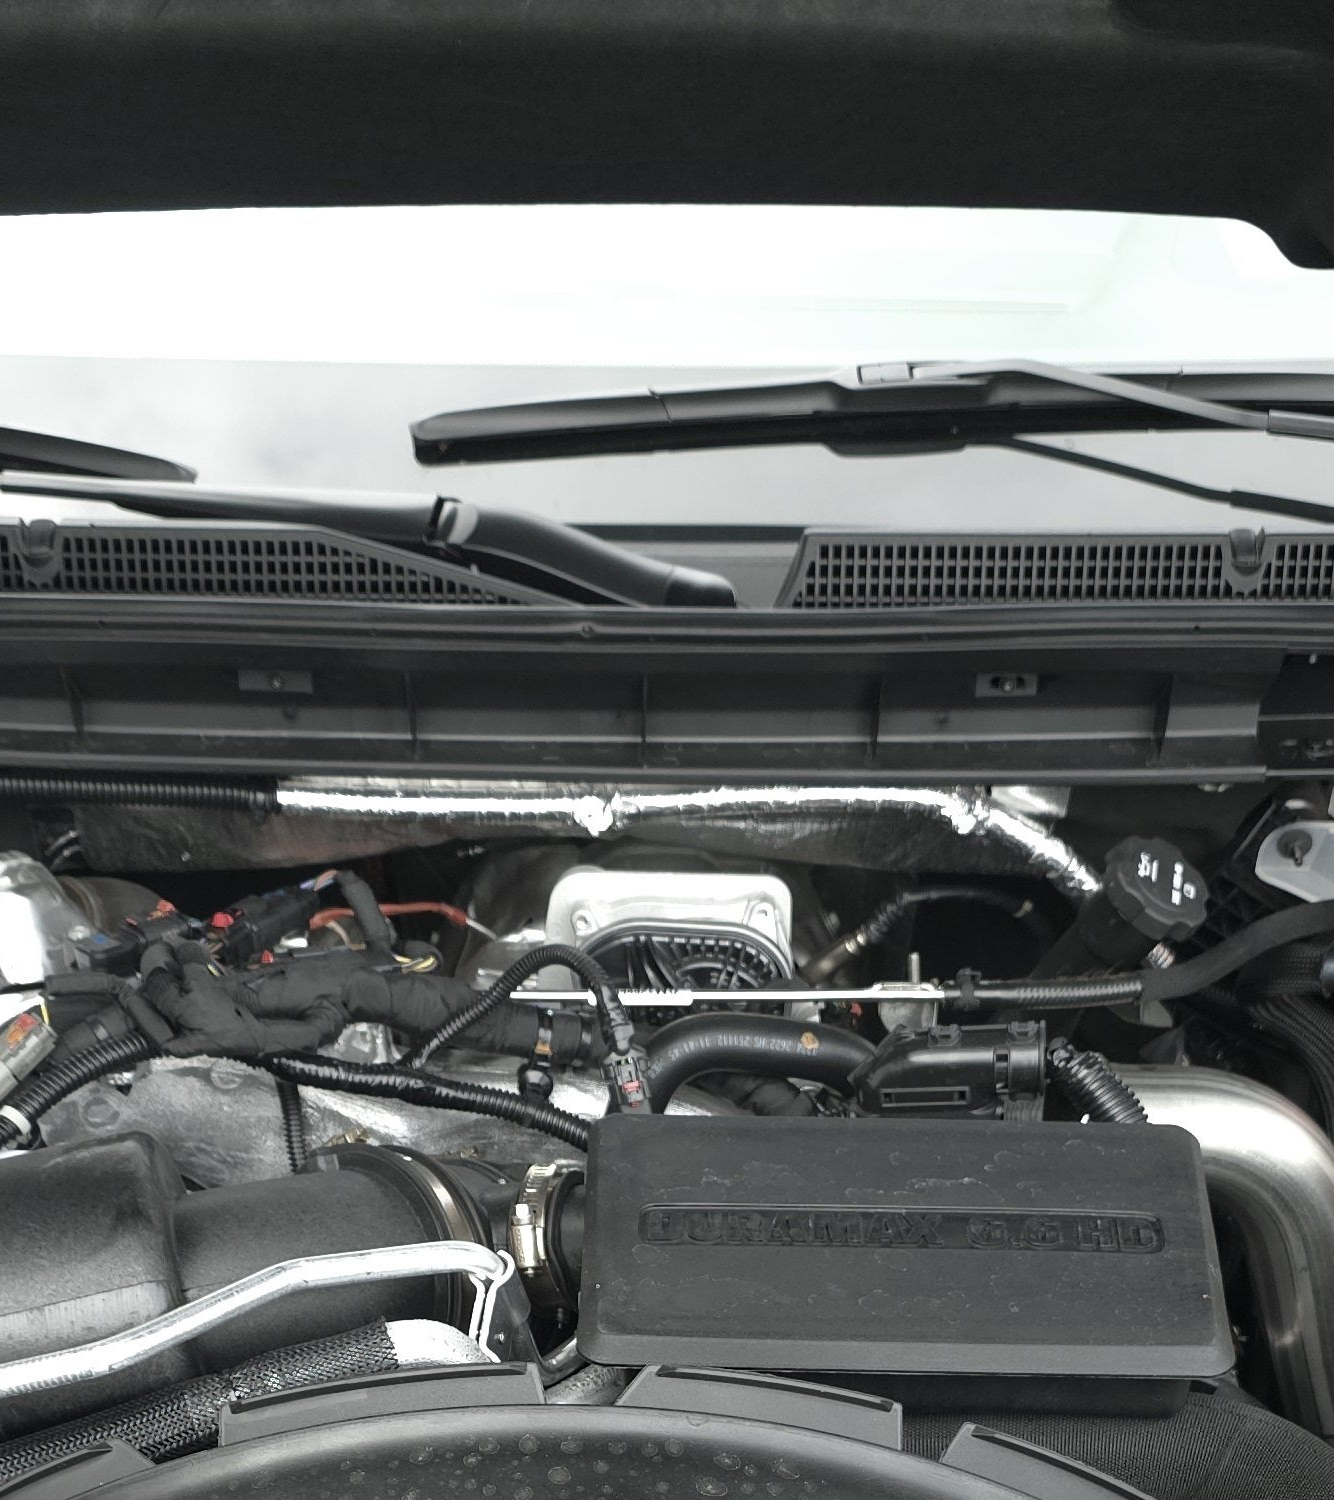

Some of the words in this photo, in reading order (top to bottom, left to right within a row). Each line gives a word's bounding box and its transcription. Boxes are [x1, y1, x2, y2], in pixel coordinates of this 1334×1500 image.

[646, 1207, 945, 1246] DURAMAX
[968, 1214, 1064, 1249] 6.6
[1075, 1216, 1158, 1250] HD
